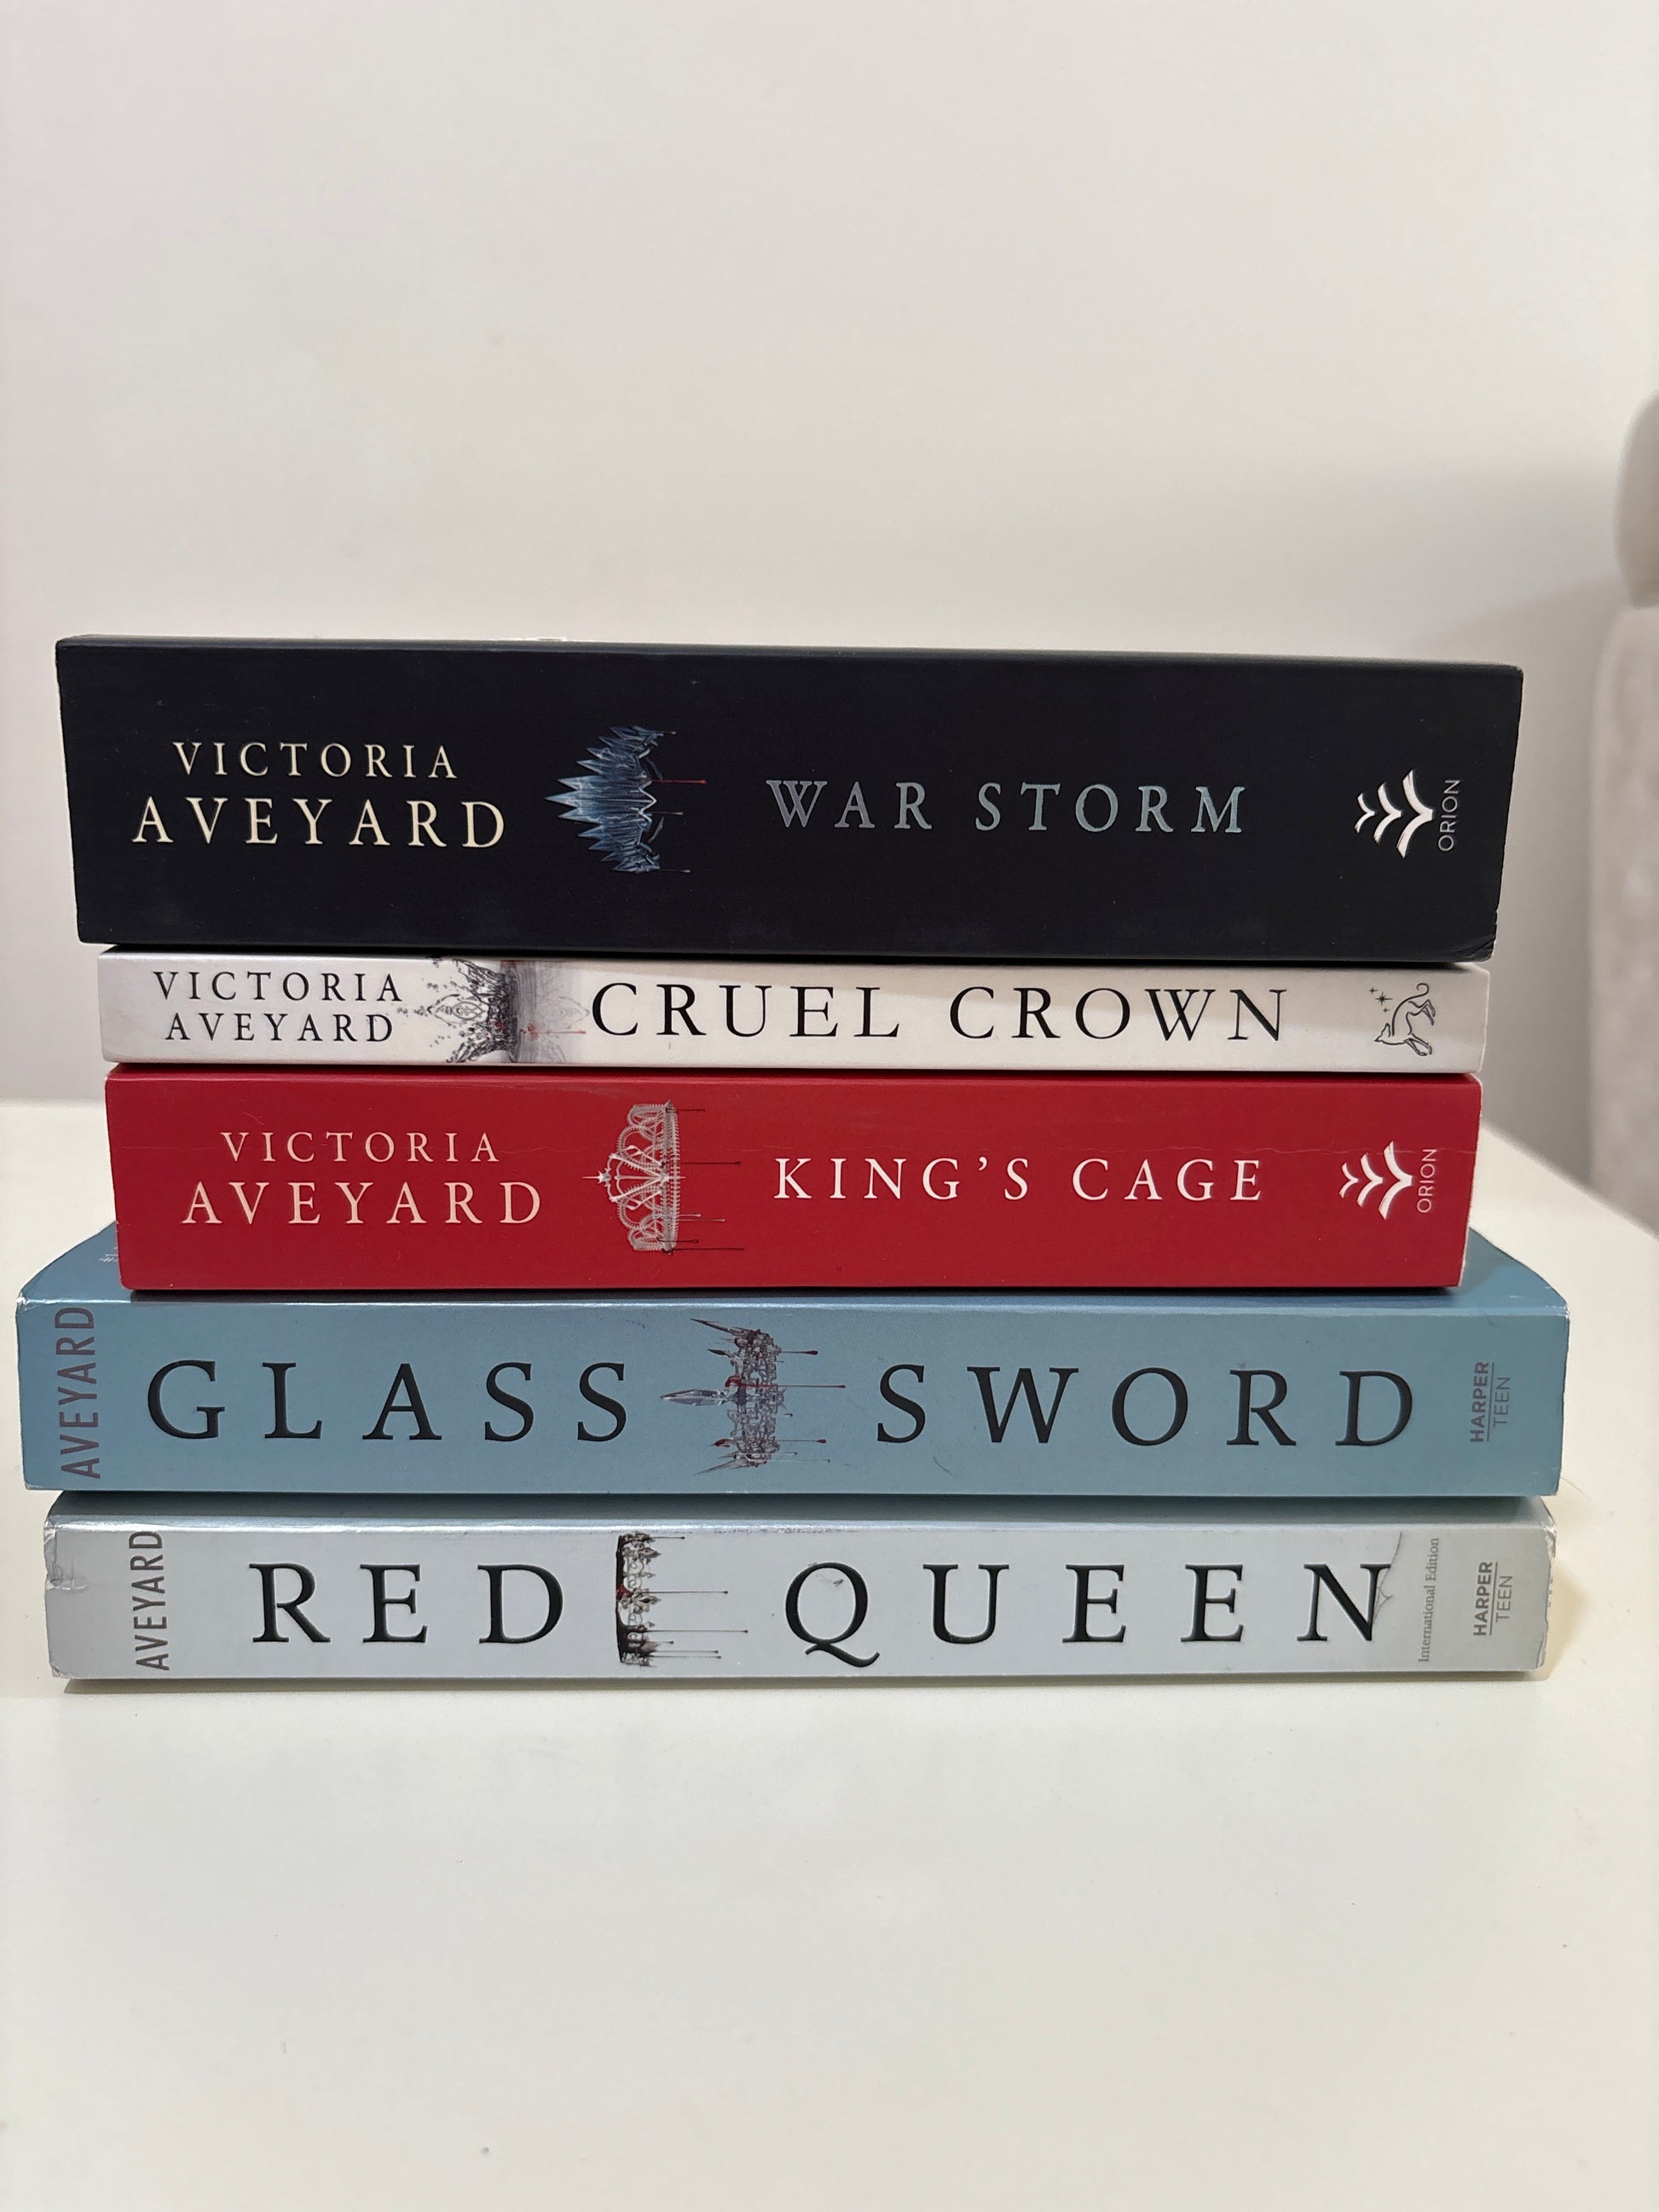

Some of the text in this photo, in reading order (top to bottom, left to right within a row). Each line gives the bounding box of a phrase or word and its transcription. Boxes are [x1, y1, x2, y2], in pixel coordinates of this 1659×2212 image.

[173, 740, 457, 781] VICTORIA
[130, 795, 506, 849] AVEYARD
[765, 779, 1246, 835] WAR STORM
[1436, 777, 1461, 853] ORION
[152, 970, 404, 1002] VICTORIA
[591, 981, 1288, 1042] CRUEL CROWN
[165, 1012, 394, 1043] AVEYARD
[220, 1130, 500, 1164] VICTORIA
[181, 1180, 541, 1225] AVEYARD
[1072, 1157, 1263, 1204] CAGE
[1415, 1147, 1438, 1215] ORION
[55, 1306, 101, 1480] AVEYARD
[146, 1358, 1414, 1447] GLASS SWORD
[1469, 1361, 1490, 1443] HARPER
[1493, 1376, 1512, 1429] TEEN
[128, 1530, 171, 1672] AVEYARD
[248, 1561, 1392, 1669] RED QUEEN
[1418, 1537, 1441, 1664] International Edition
[1472, 1561, 1494, 1637] HARPER
[1494, 1574, 1514, 1624] TEEN
